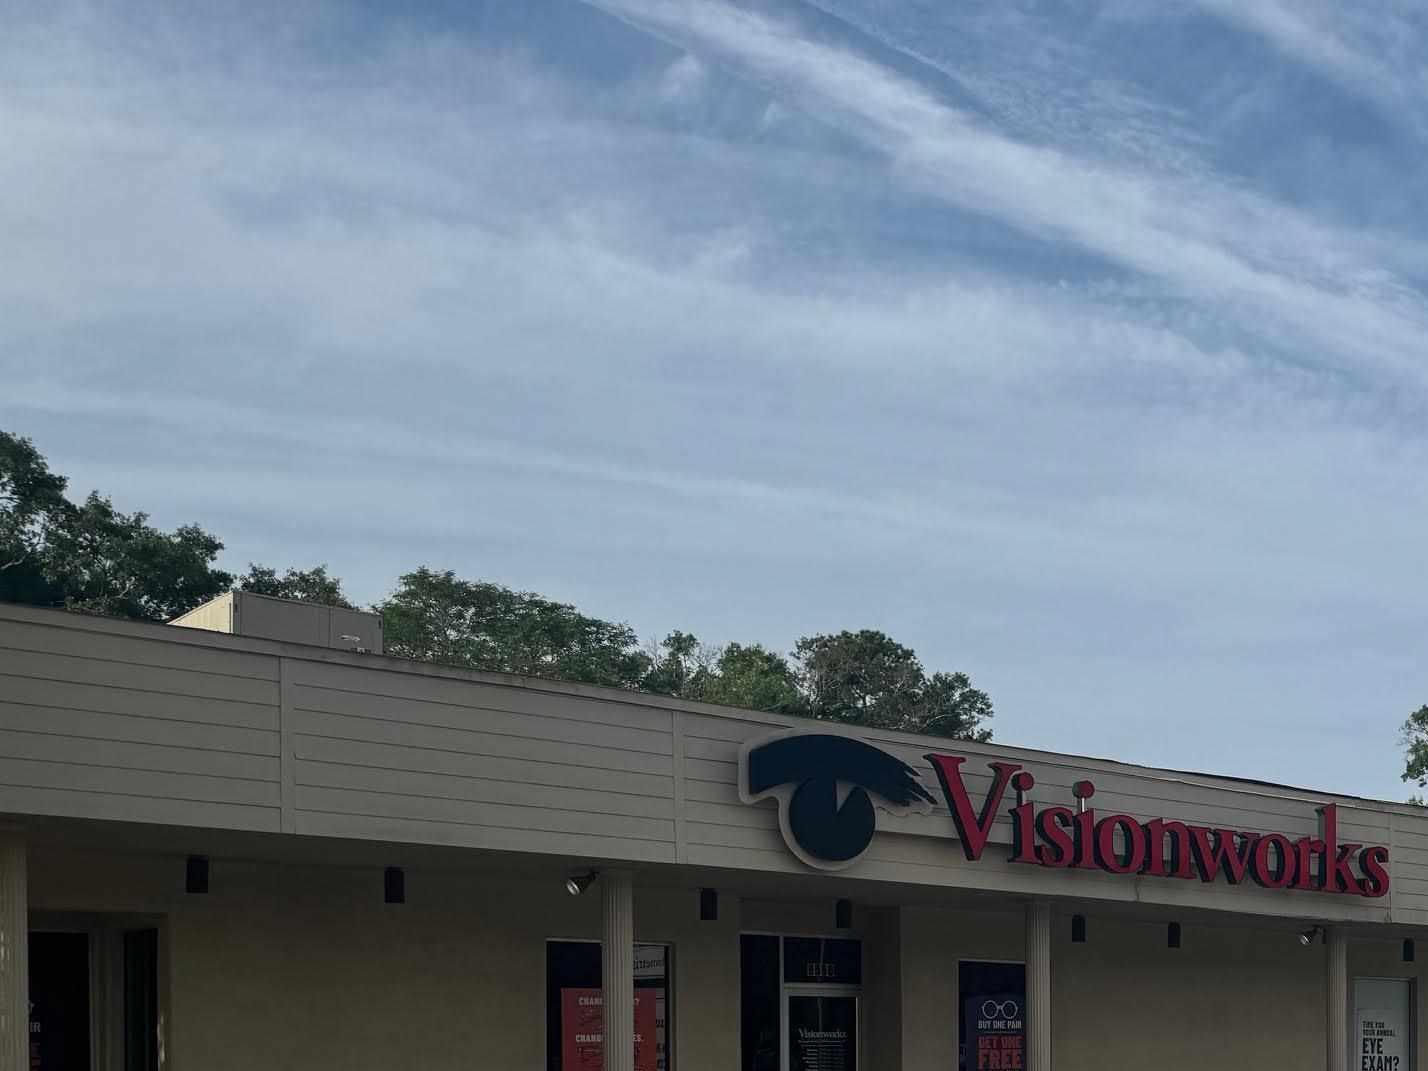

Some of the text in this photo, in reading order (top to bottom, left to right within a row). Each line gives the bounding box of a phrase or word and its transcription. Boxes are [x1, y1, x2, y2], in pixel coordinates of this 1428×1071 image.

[922, 753, 1391, 898] Visionworks
[1362, 1038, 1384, 1054] EYE
[978, 1049, 1022, 1070] FREE
[1361, 1056, 1400, 1071] EXAM?
